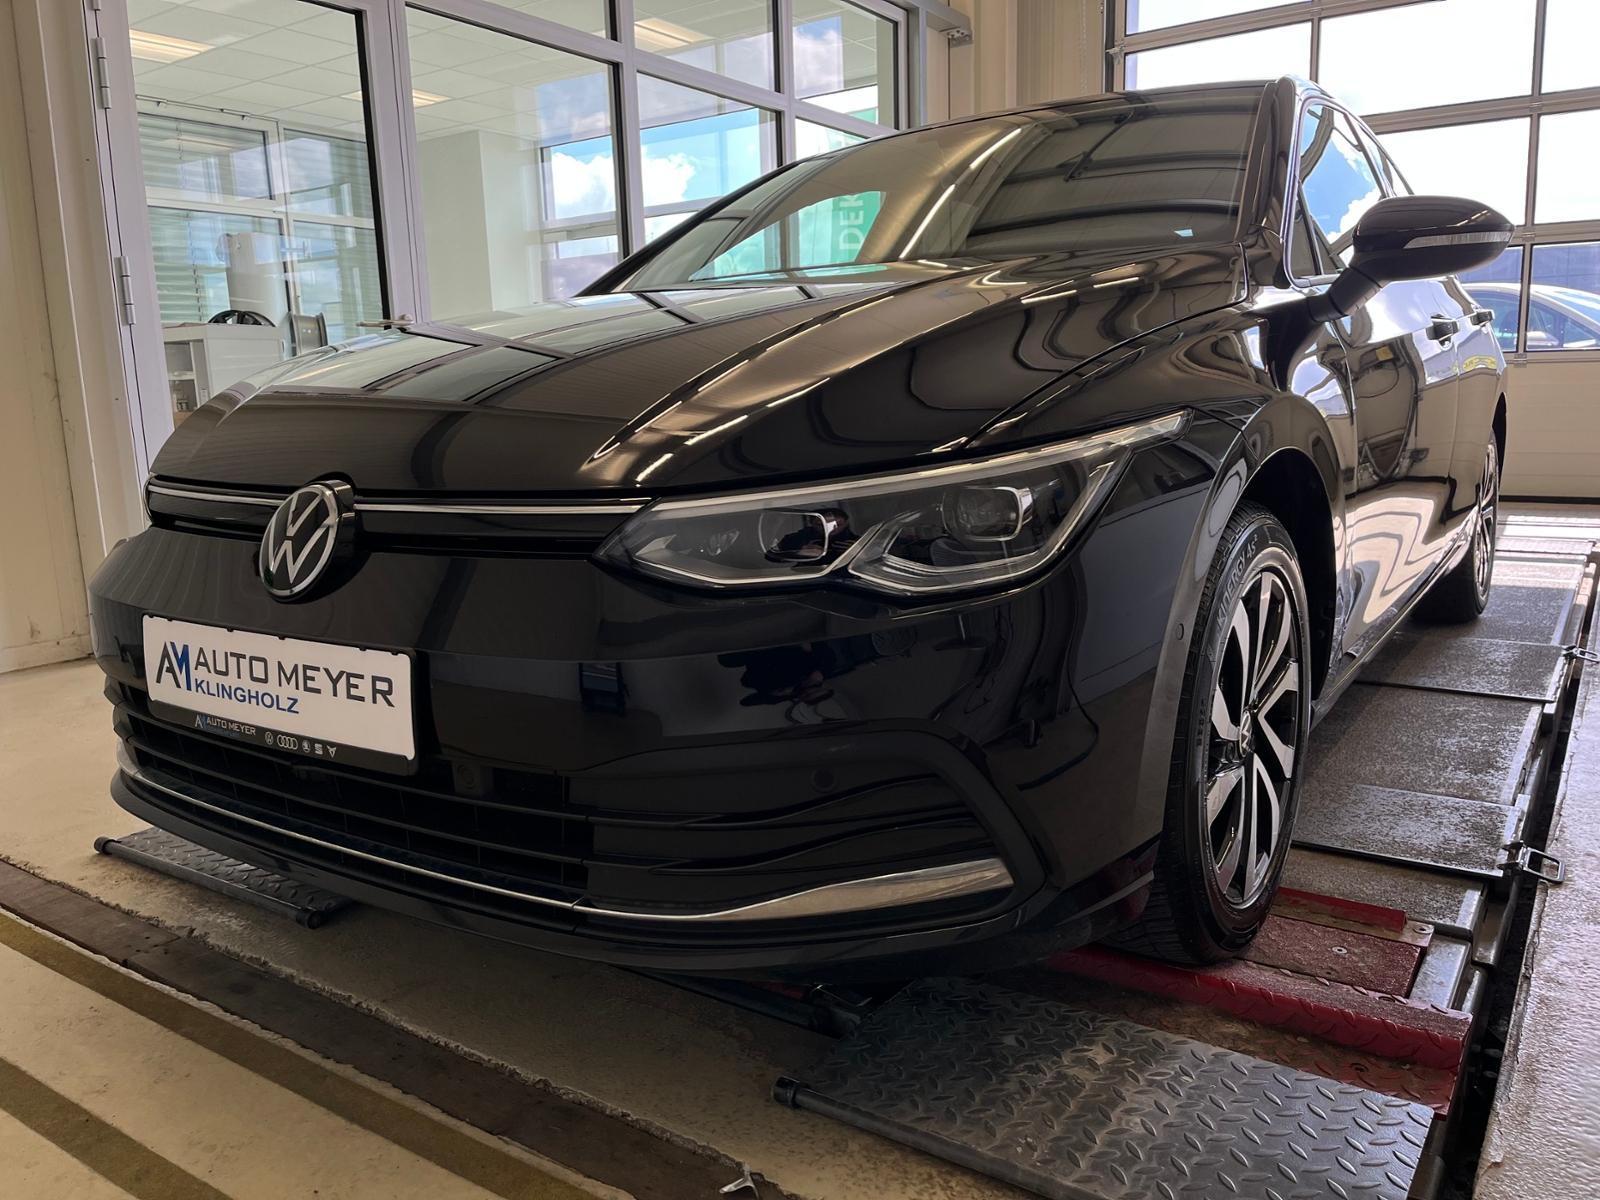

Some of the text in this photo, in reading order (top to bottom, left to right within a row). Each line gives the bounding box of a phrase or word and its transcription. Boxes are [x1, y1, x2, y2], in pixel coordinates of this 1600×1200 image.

[194, 647, 395, 708] AUTO MEYER
[194, 678, 299, 714] KLINGHOLZ
[206, 717, 227, 729] AUTO
[228, 722, 257, 736] MEYER
